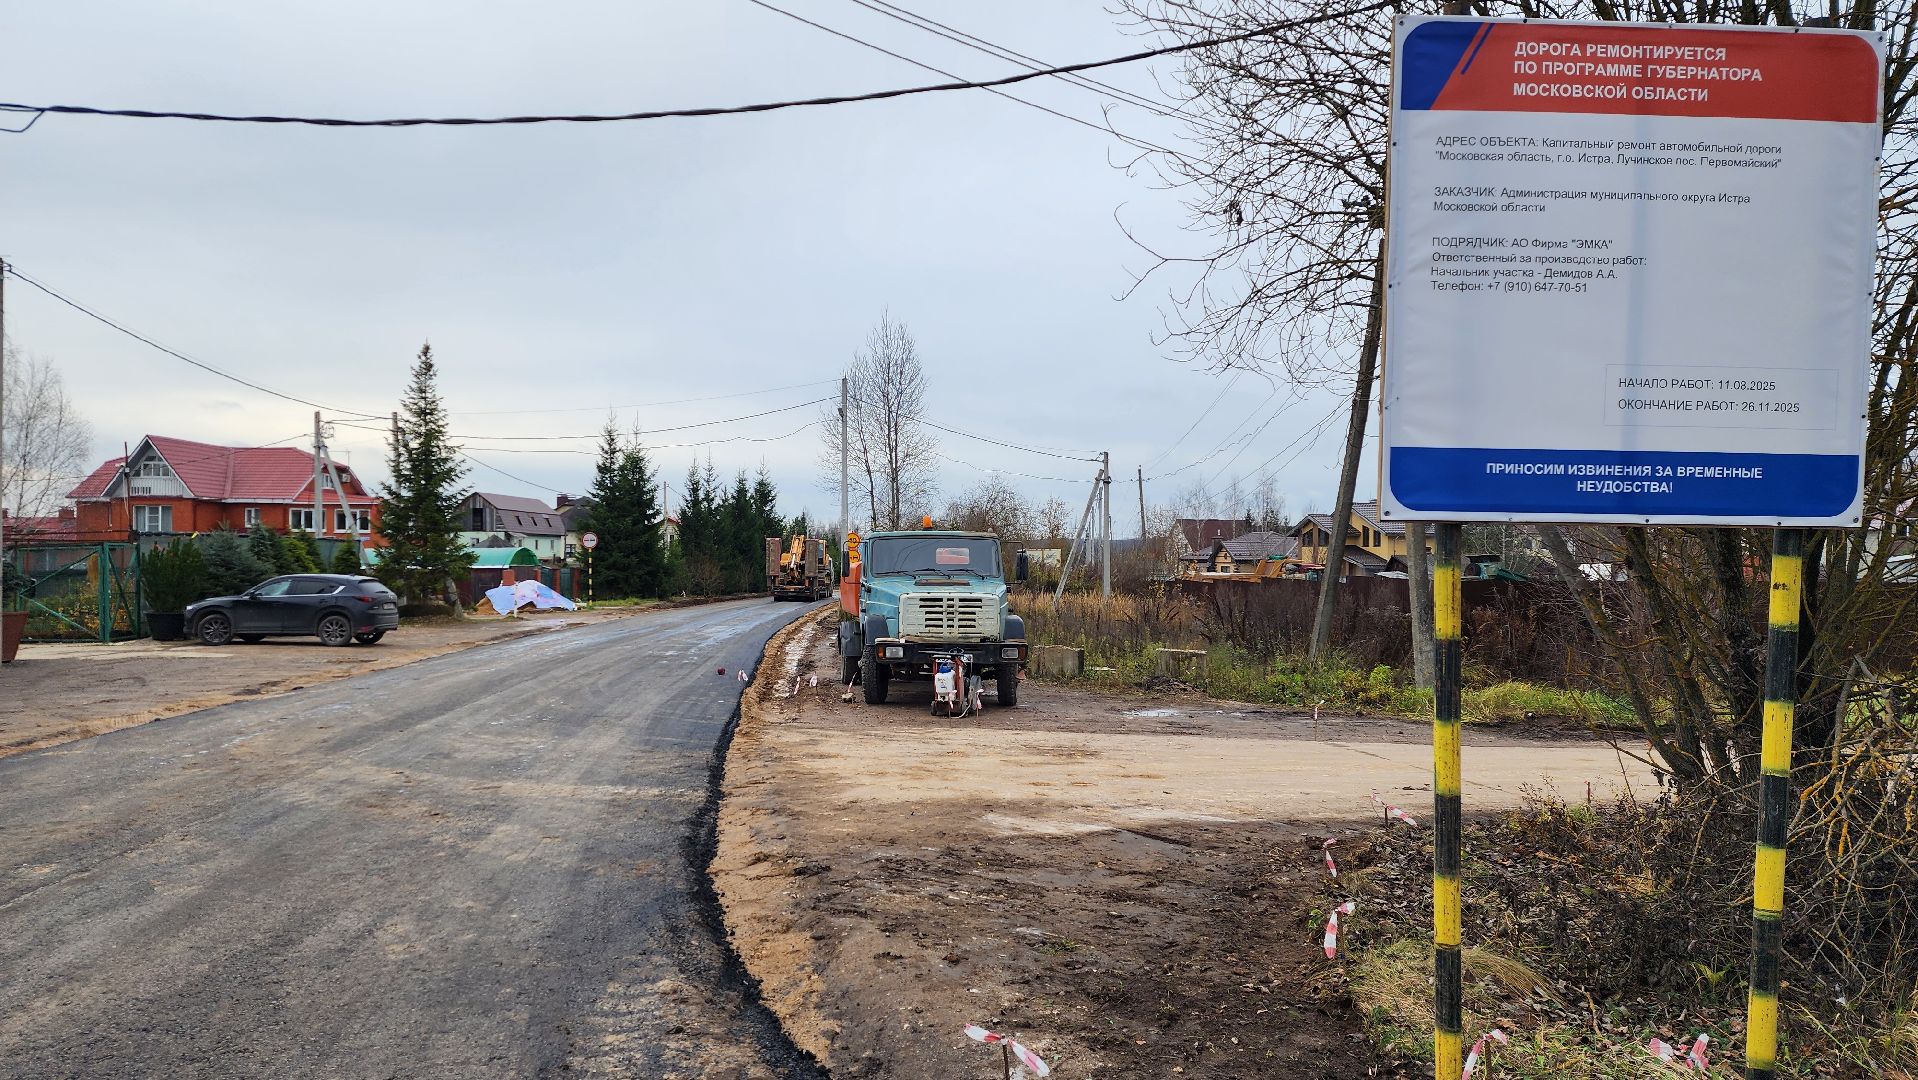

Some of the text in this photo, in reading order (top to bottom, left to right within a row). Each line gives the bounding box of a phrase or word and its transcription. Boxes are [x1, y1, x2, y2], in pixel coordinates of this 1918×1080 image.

[1515, 42, 1726, 60] ДОРОГА РЕМОНТИРУЕТСЯ
[1514, 60, 1762, 82] ПО ПРОГРАММЕ ГУБЕРНАТОРА
[1514, 82, 1708, 102] МОСКОВСКОЙ ОБЛАСТИ
[1436, 136, 1782, 154] АДРЕС ОБЪЕКТА: Капитальный ремонт автомобильной дороги
[1436, 150, 1503, 161] "Московская
[1507, 152, 1554, 162] область,
[1557, 154, 1574, 162] г.о.
[1617, 154, 1672, 165] Лучинское
[1676, 157, 1697, 166] пос.
[1701, 156, 1782, 168] Первомайский"
[1500, 188, 1587, 200] Администрация
[1590, 191, 1678, 201] муниципального
[1681, 194, 1716, 204] округа
[1719, 193, 1750, 204] Истра
[1434, 201, 1545, 212] Московской области
[1432, 237, 1613, 250] ПОДРЯДЧИК: АО Фирма "ЭМКА"
[1535, 256, 1609, 266] производство
[1612, 256, 1647, 267] работ:
[1431, 267, 1489, 277] Начальник
[1493, 269, 1534, 279] участка
[1544, 269, 1593, 279] Демидов
[1596, 270, 1618, 279] А.А.
[1431, 281, 1587, 293] Телефон: +7 (910) 647-70-51
[1618, 378, 1776, 391] НАЧАЛО РАБОТ: 11.08.2025
[1618, 399, 1800, 413] ОКОНЧАНИЕ РАБОТ: 26.11.2025
[1486, 462, 1763, 478] ПРИНОСИМ ИЗВИНЕНИЯ ЗА ВРЕМЕННЫЕ
[1577, 480, 1673, 493] НЕУДОБСТВА!
